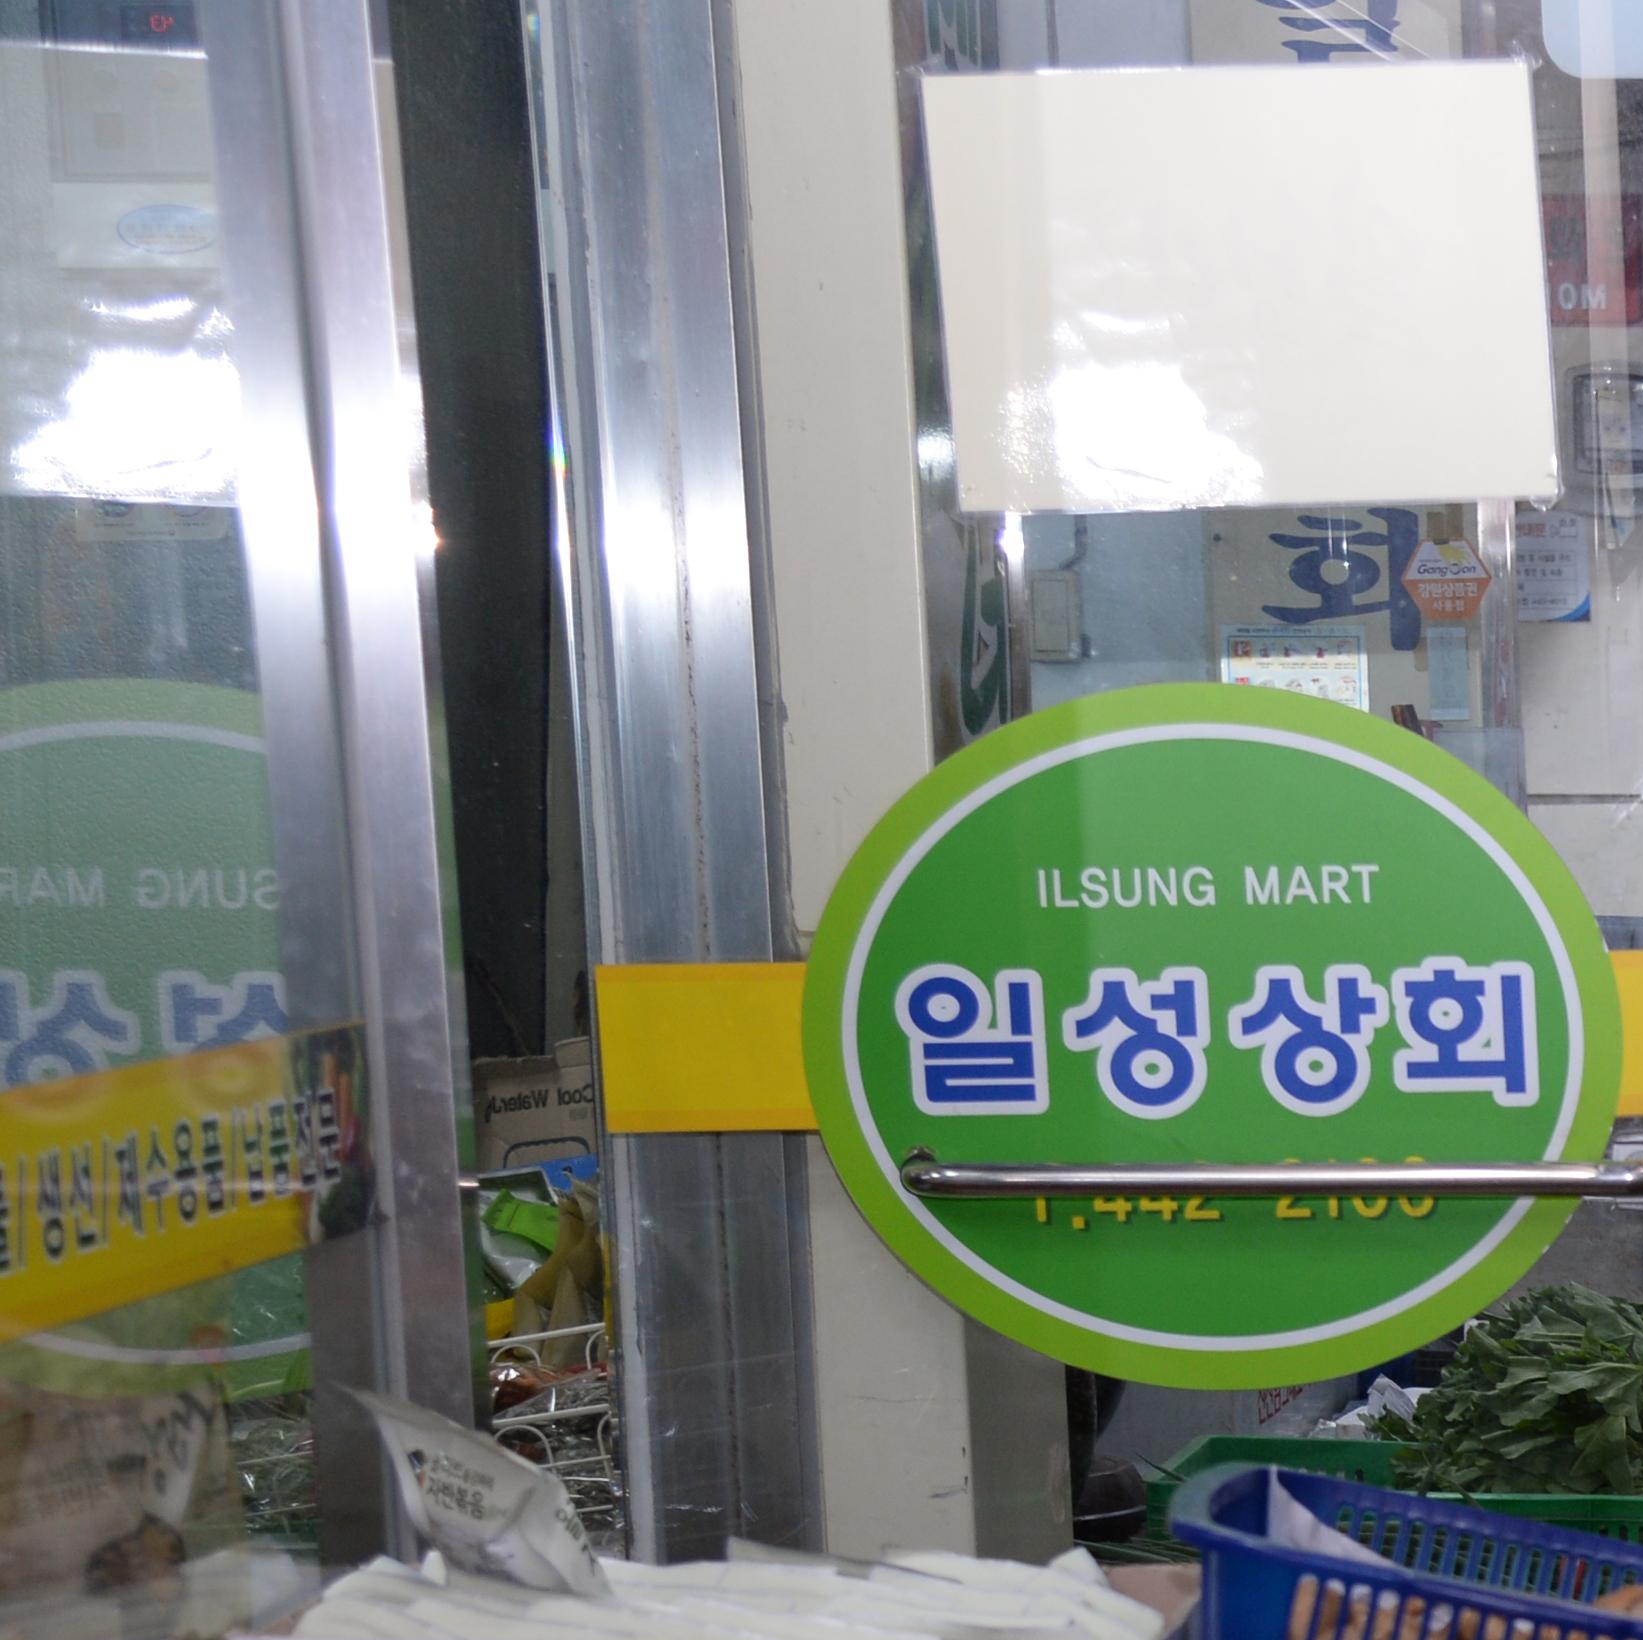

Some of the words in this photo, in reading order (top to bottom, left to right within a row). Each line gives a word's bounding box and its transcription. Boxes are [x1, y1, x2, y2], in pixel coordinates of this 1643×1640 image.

[1036, 867, 1216, 908] ILSUNG
[1244, 864, 1380, 905] MART
[902, 962, 1534, 1113] 일성상회
